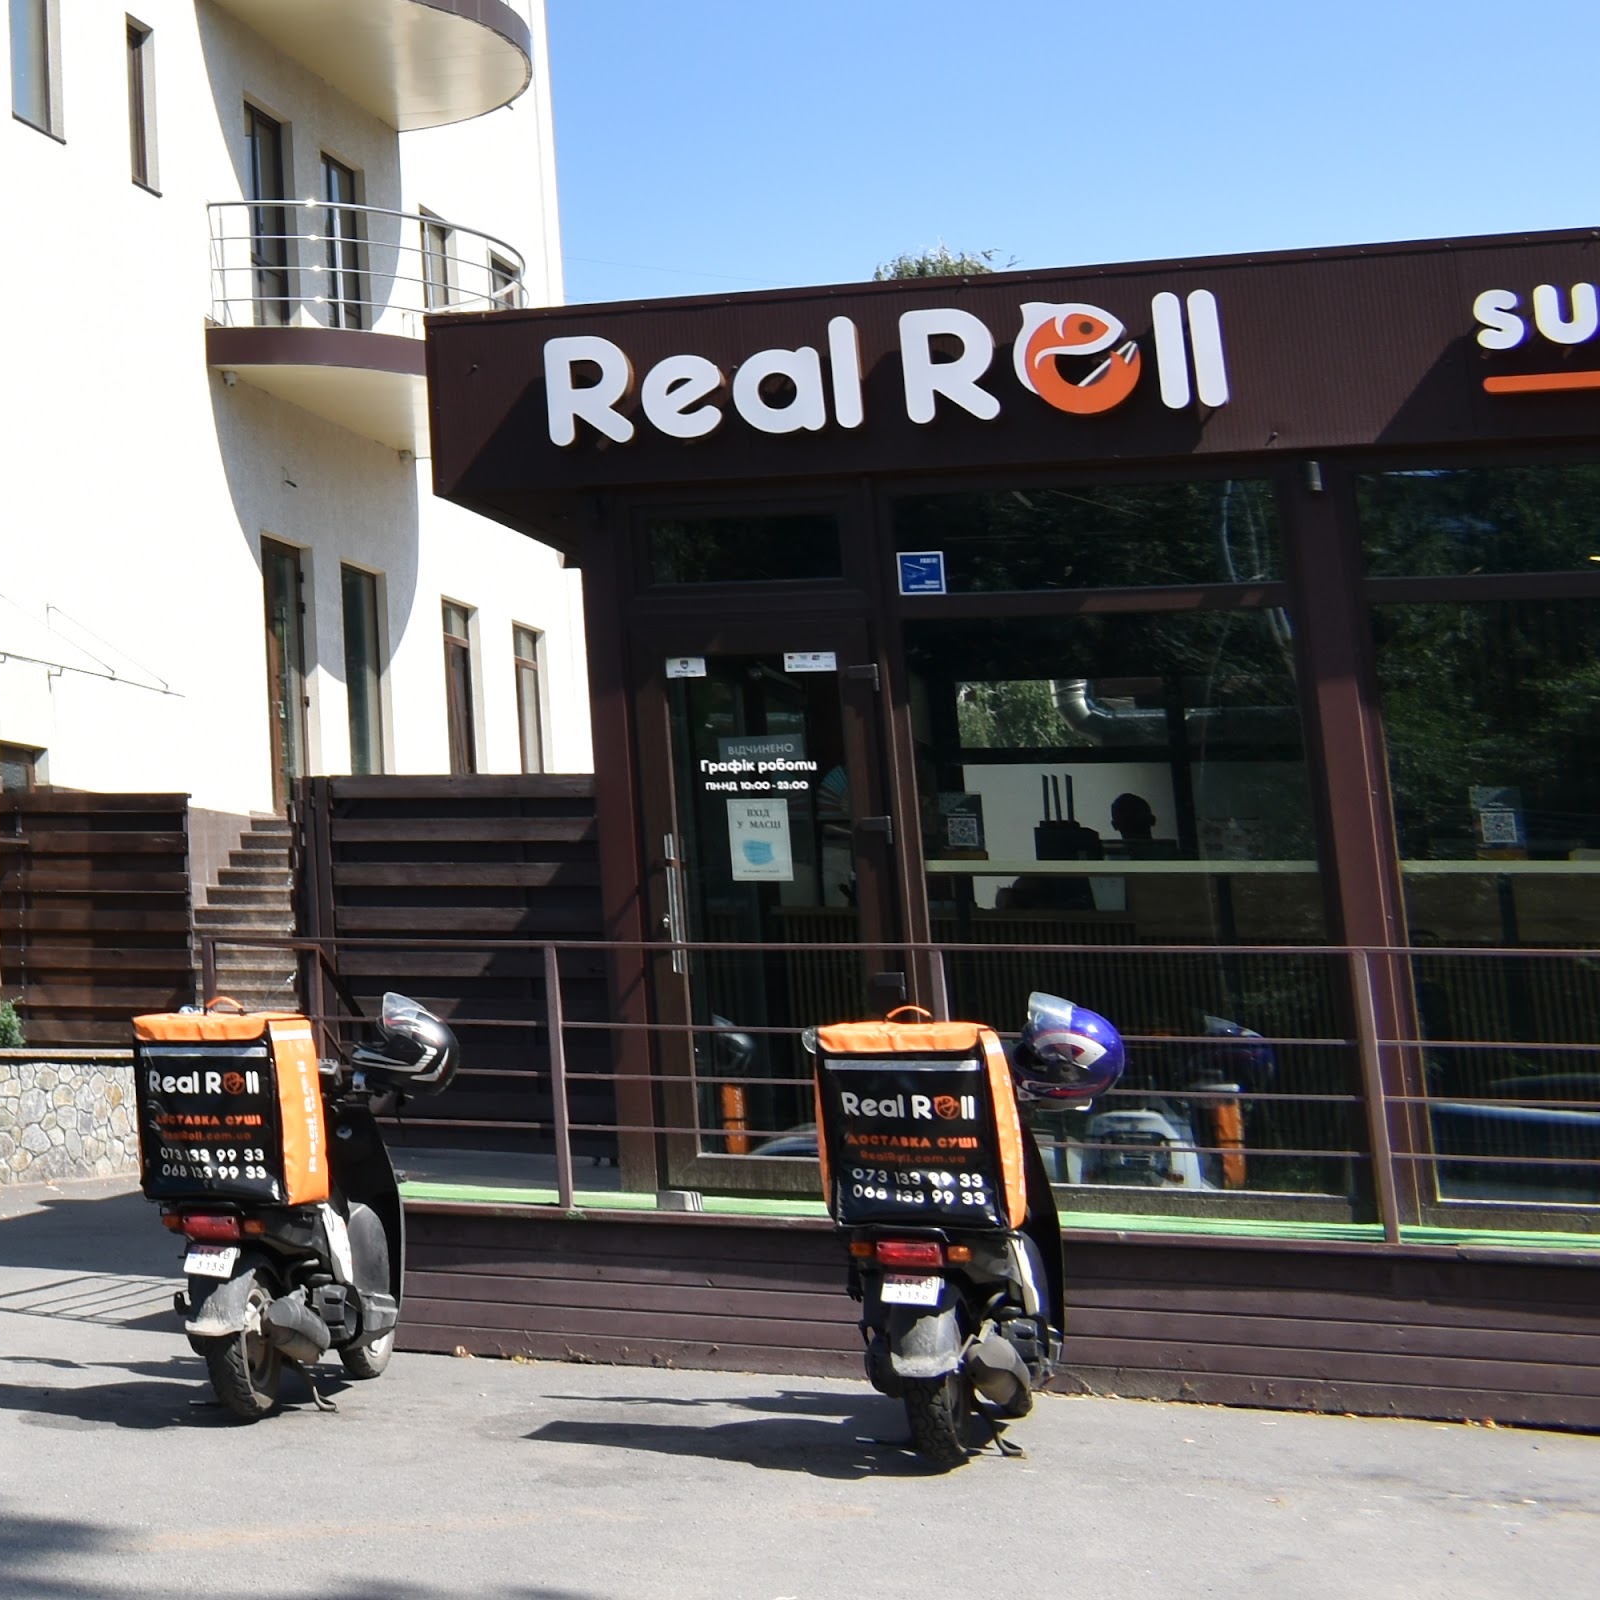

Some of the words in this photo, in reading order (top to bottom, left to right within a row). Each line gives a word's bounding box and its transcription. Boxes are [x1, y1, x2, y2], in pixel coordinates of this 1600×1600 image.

[543, 315, 865, 447] Real
[899, 289, 1229, 427] Roll
[727, 743, 794, 755] ВІДЧИНЕНО
[700, 759, 756, 775] Графік
[757, 758, 818, 774] роботи
[740, 781, 770, 790] 10:00
[777, 781, 809, 790] 23:00
[747, 809, 770, 818] ВХІД
[749, 820, 781, 829] МАСЦІ
[148, 1070, 199, 1093] Real
[205, 1070, 260, 1095] Roll
[841, 1092, 905, 1119] Real
[911, 1093, 975, 1120] Roll
[847, 1133, 931, 1148] ДОСТАВКА
[937, 1137, 978, 1149] СУШІ
[161, 1147, 182, 1161] 073
[186, 1148, 211, 1162] 133
[216, 1148, 237, 1162] 99
[244, 1148, 265, 1161] 33
[162, 1164, 187, 1177] 068
[191, 1165, 213, 1179] 133
[217, 1166, 240, 1180] 99
[245, 1165, 267, 1179] 33
[852, 1168, 888, 1183] 073
[894, 1171, 921, 1185] 133
[928, 1171, 953, 1186] 99
[960, 1173, 983, 1188] 33
[853, 1185, 888, 1200] 068
[896, 1190, 925, 1204] 133
[931, 1190, 955, 1205] 99
[962, 1191, 986, 1205] 33
